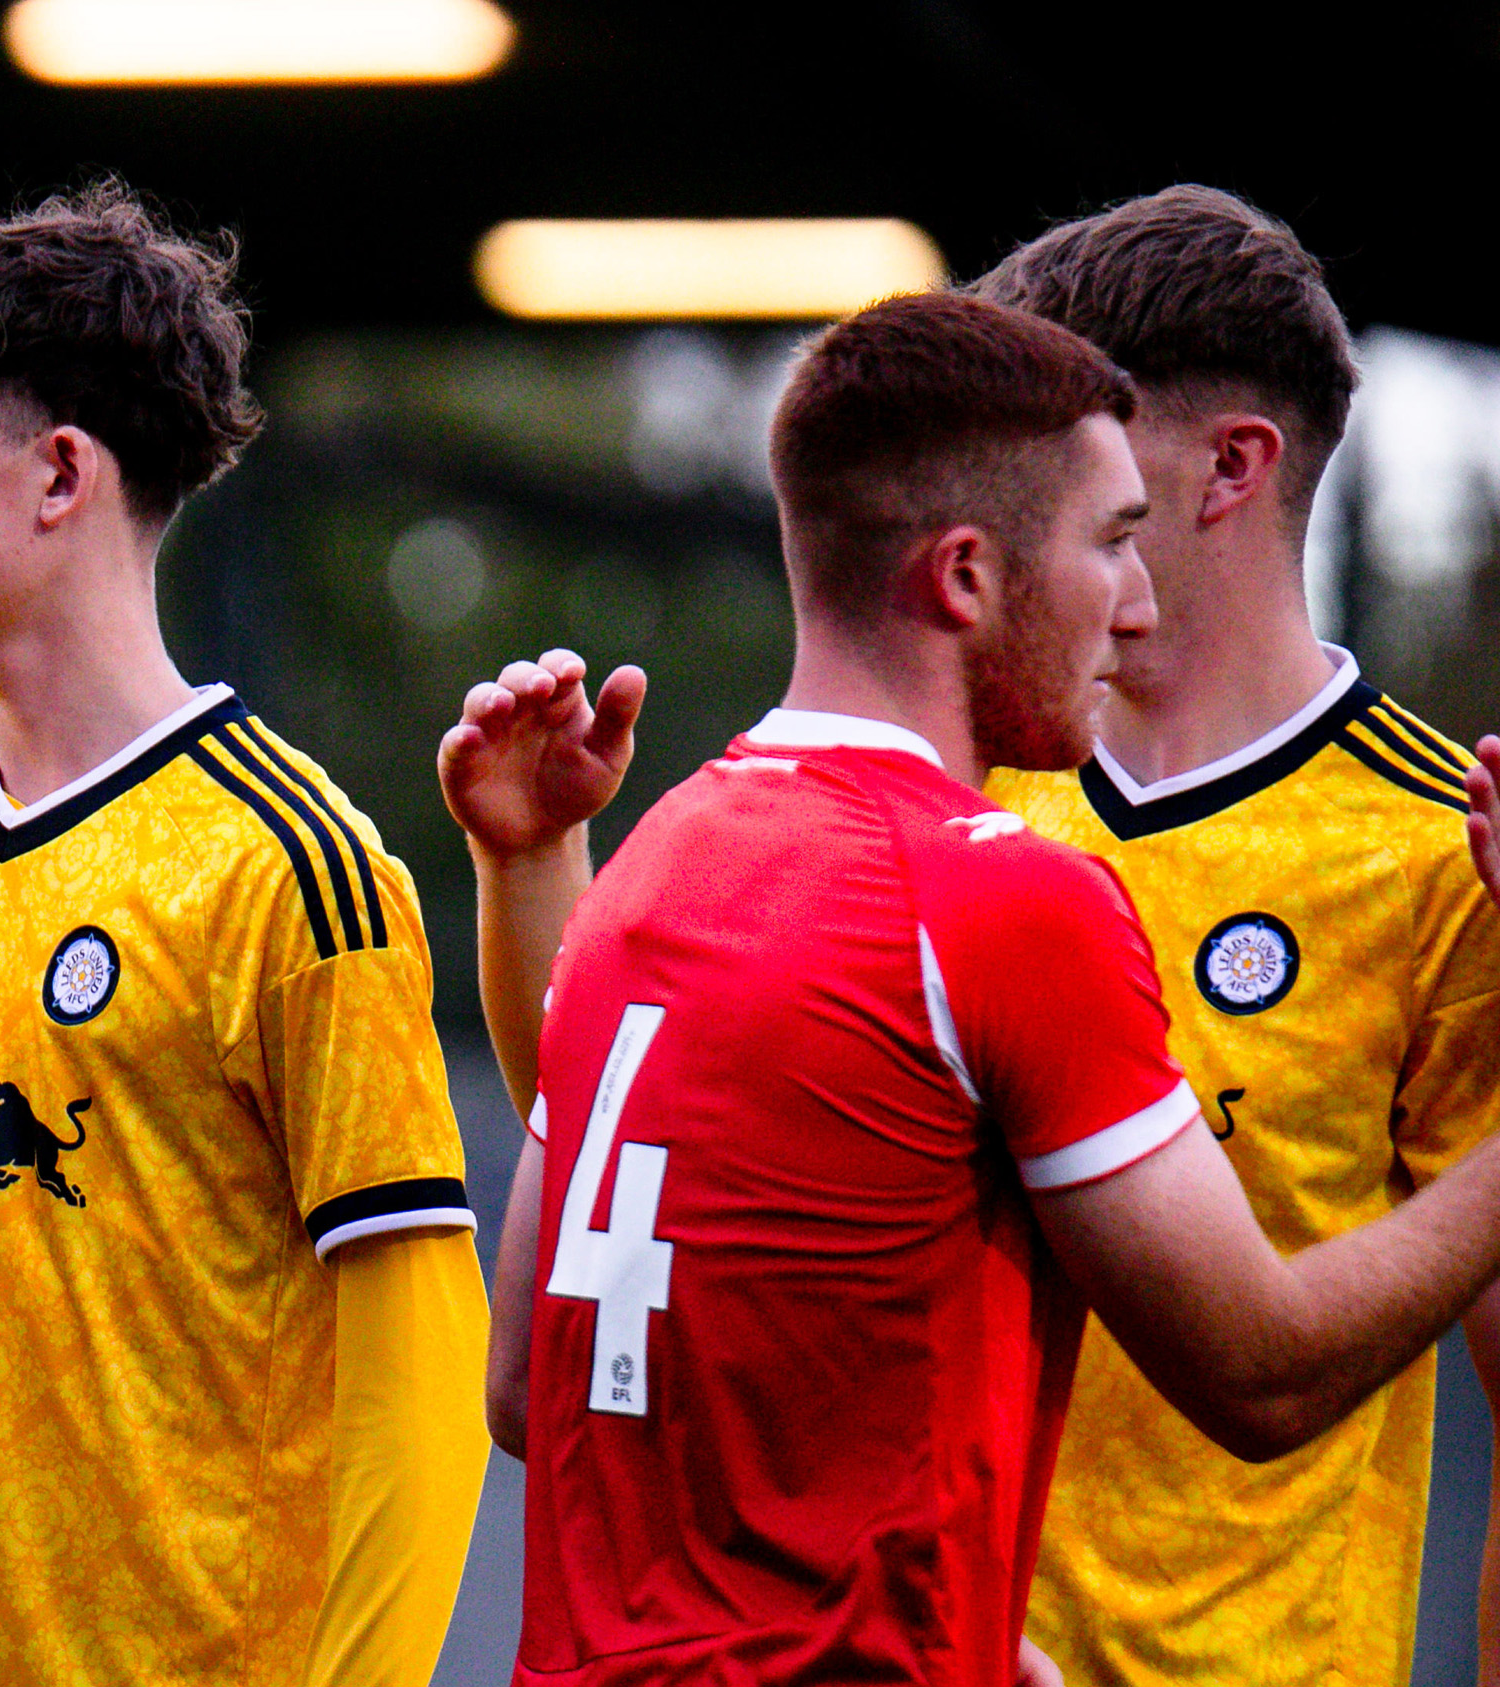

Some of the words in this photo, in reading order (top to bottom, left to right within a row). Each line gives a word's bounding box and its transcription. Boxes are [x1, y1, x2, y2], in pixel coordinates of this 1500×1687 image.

[61, 948, 85, 986] LEEDS
[90, 949, 104, 994] UNITED
[1219, 935, 1251, 971] LEEDS
[1258, 938, 1276, 983] UNITED
[65, 992, 85, 1004] AFC
[546, 1003, 674, 1416] 4
[612, 1387, 632, 1402] EFL
